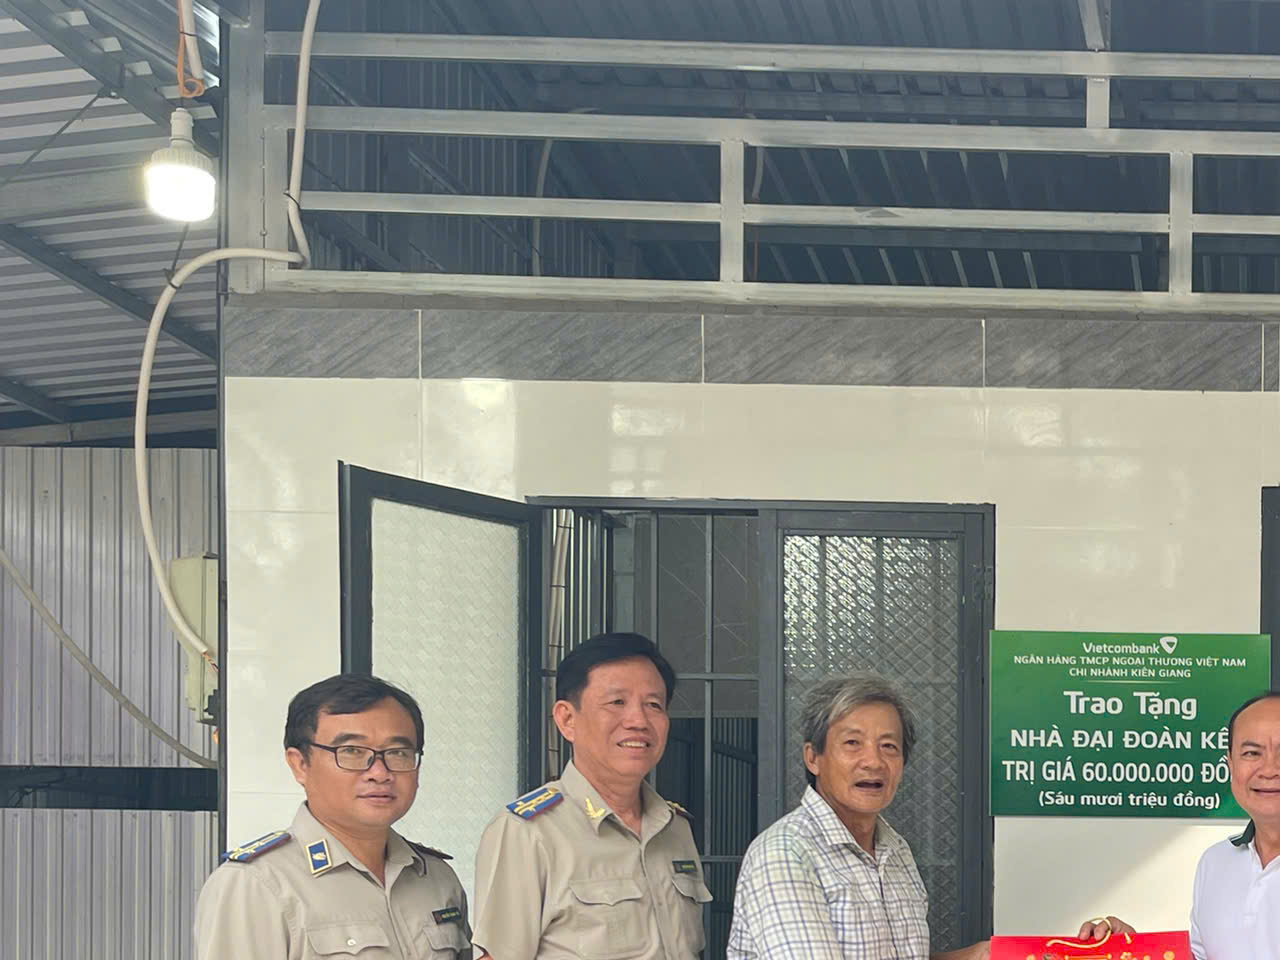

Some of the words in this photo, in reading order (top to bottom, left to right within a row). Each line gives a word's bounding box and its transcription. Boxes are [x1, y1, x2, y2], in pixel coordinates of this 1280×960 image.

[1082, 641, 1160, 654] Vietcombank
[1080, 656, 1109, 665] TMCP
[1222, 658, 1246, 667] NAM
[1069, 667, 1087, 676] CHI
[1158, 669, 1191, 678] GIANG
[1063, 690, 1123, 715] Trao
[1133, 691, 1197, 720] Tặng
[1010, 724, 1063, 748] NHÀ
[1072, 729, 1113, 752] ĐẠI
[1122, 725, 1192, 749] ĐOÀN
[1001, 760, 1035, 785] TRỊ
[1041, 755, 1076, 782] GIÁ
[1082, 762, 1194, 783] 60.000.000
[1200, 754, 1232, 783] ĐỒ
[1038, 790, 1075, 807] (Sáu
[1080, 792, 1123, 806] mươi
[1128, 792, 1168, 808] triệu
[1173, 790, 1220, 810] đồng)
